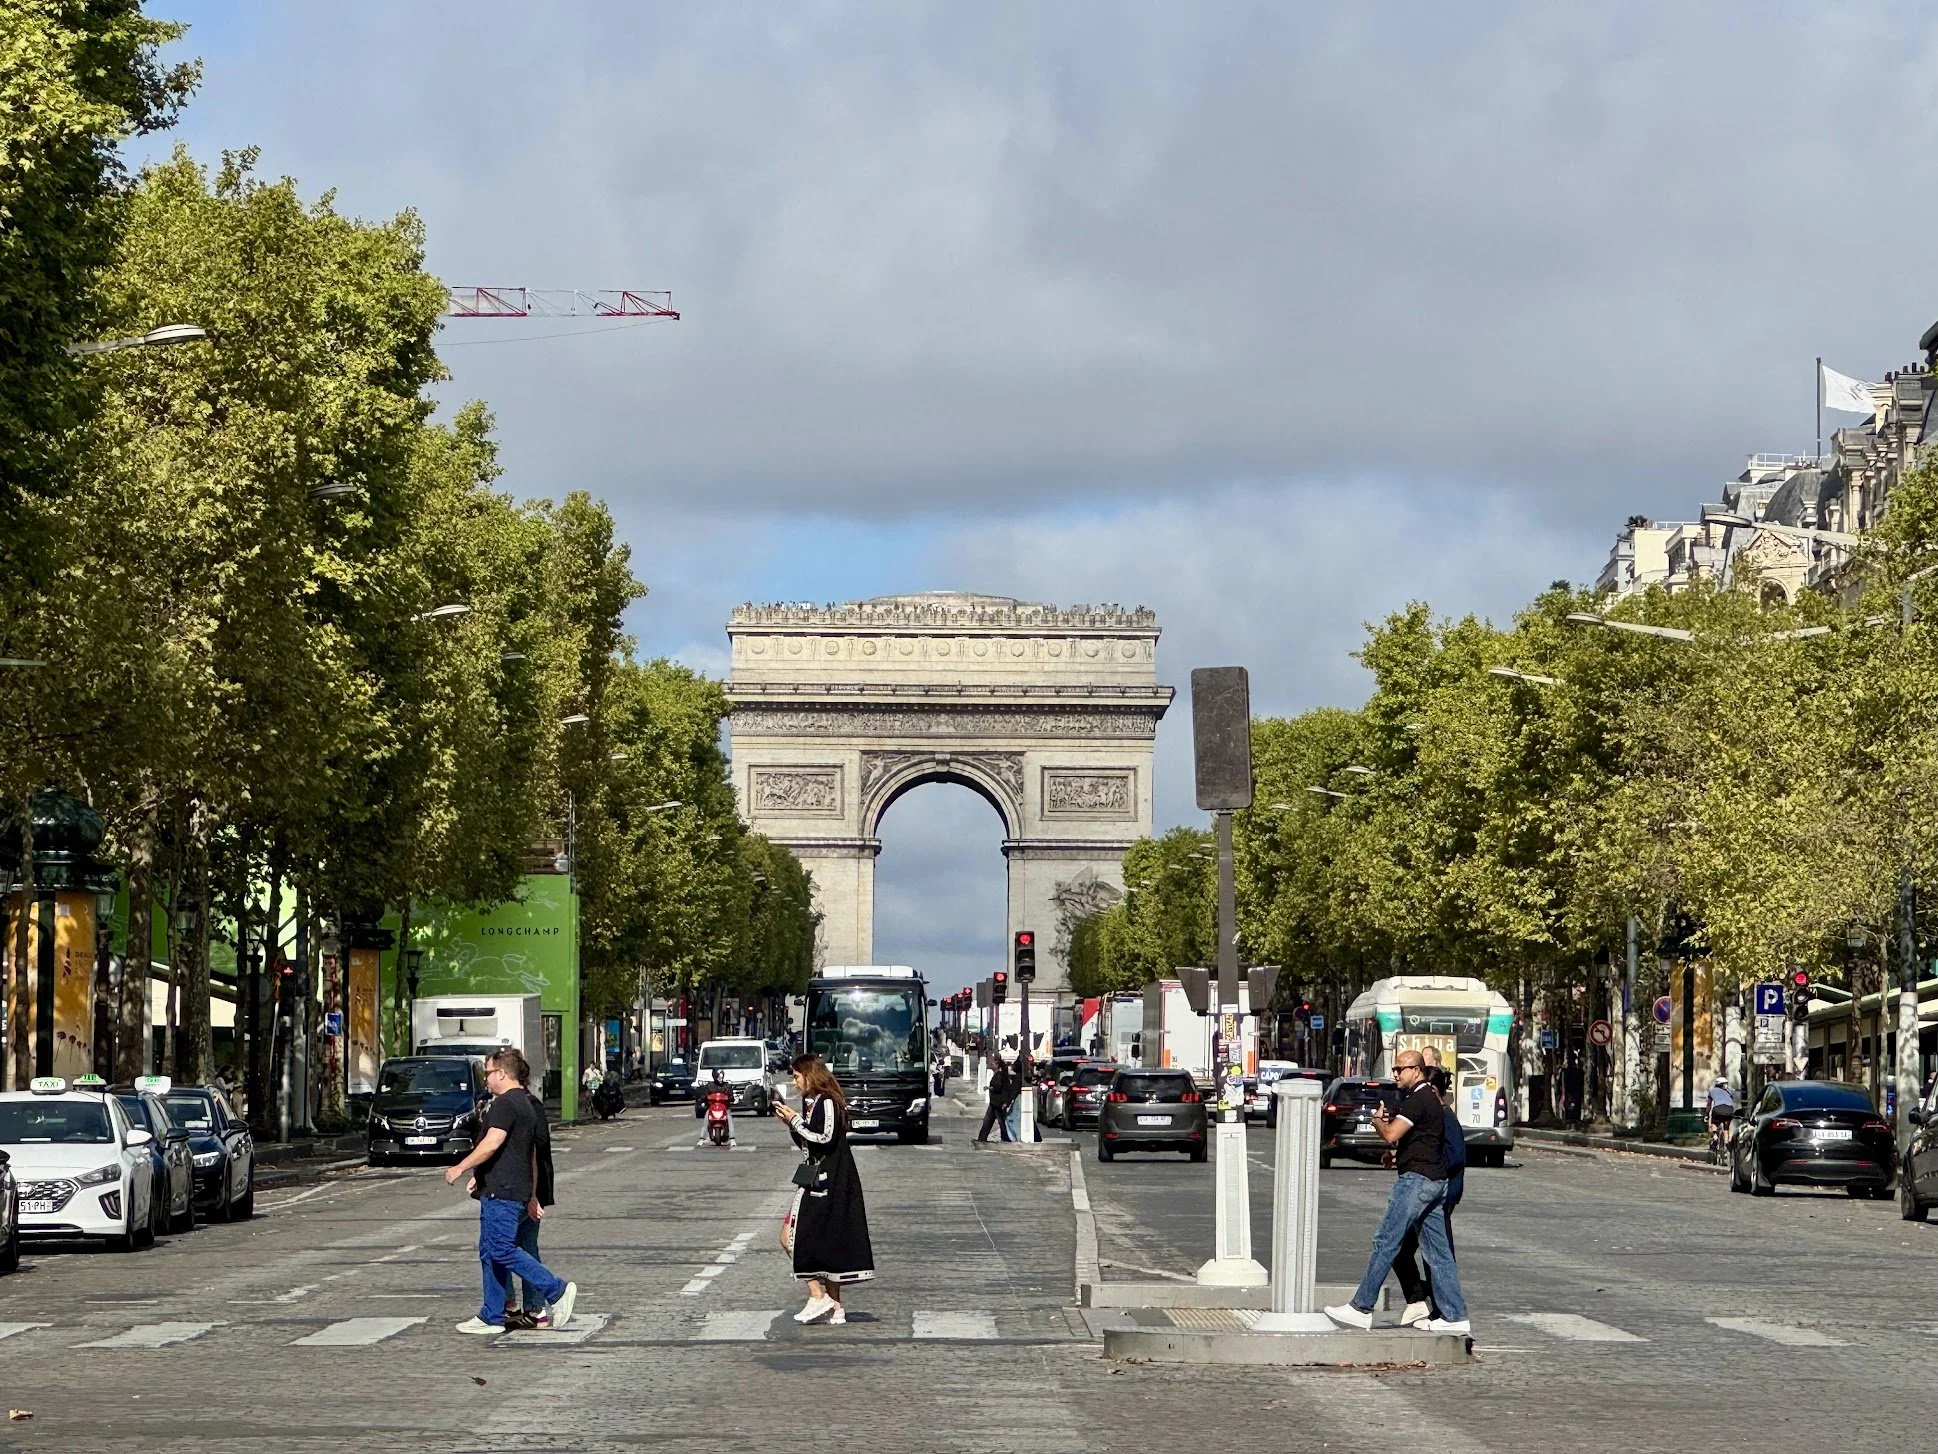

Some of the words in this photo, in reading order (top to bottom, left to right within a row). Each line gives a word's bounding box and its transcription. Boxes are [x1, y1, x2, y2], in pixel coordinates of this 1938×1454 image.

[481, 927, 559, 936] LONGCHAMP
[1763, 988, 1779, 1010] P
[1463, 1022, 1477, 1033] 73
